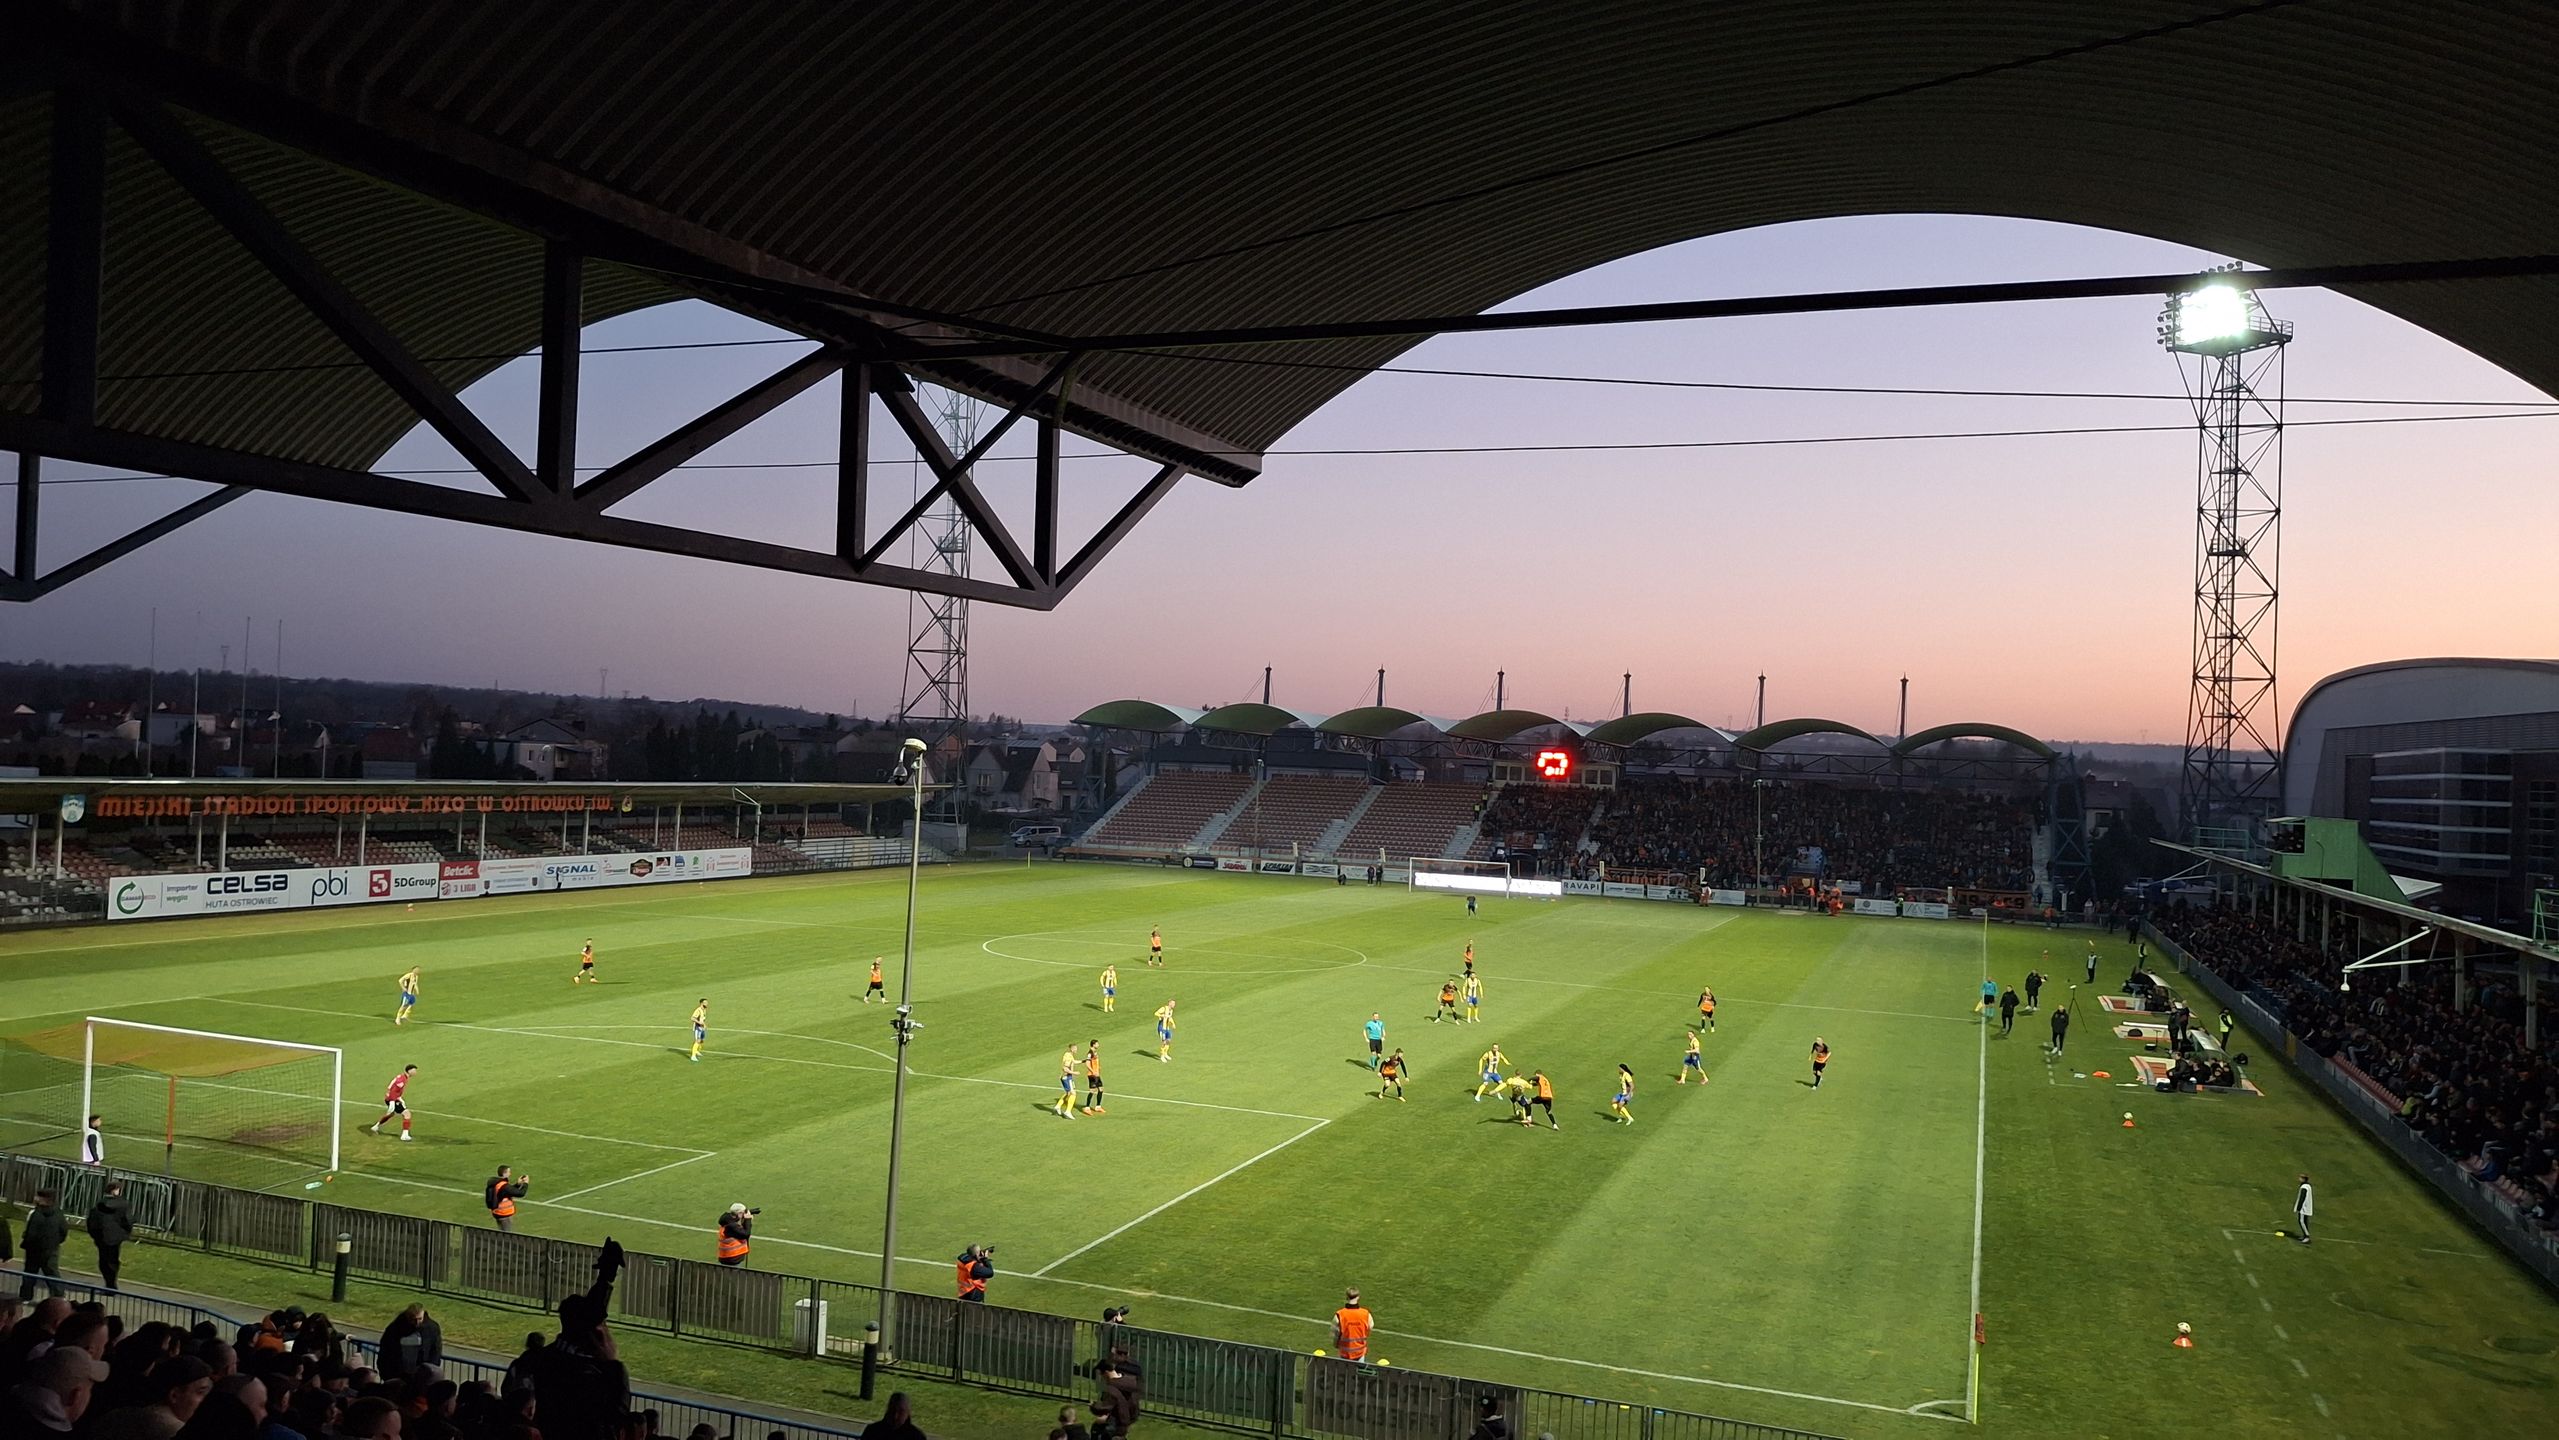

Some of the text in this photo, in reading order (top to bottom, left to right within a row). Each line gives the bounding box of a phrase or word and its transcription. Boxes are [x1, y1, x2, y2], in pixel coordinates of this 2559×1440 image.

[304, 795, 409, 814] SPORTOWY
[477, 796, 493, 812] W
[502, 795, 584, 812] OSTROWCU
[444, 865, 474, 876] Betclic
[546, 865, 597, 875] SIGNAL
[311, 870, 348, 905] pbi
[394, 877, 436, 889] 5DGroup
[1563, 881, 1599, 891] RAVAPI
[205, 896, 278, 908] HUTA OSTROWIEC
